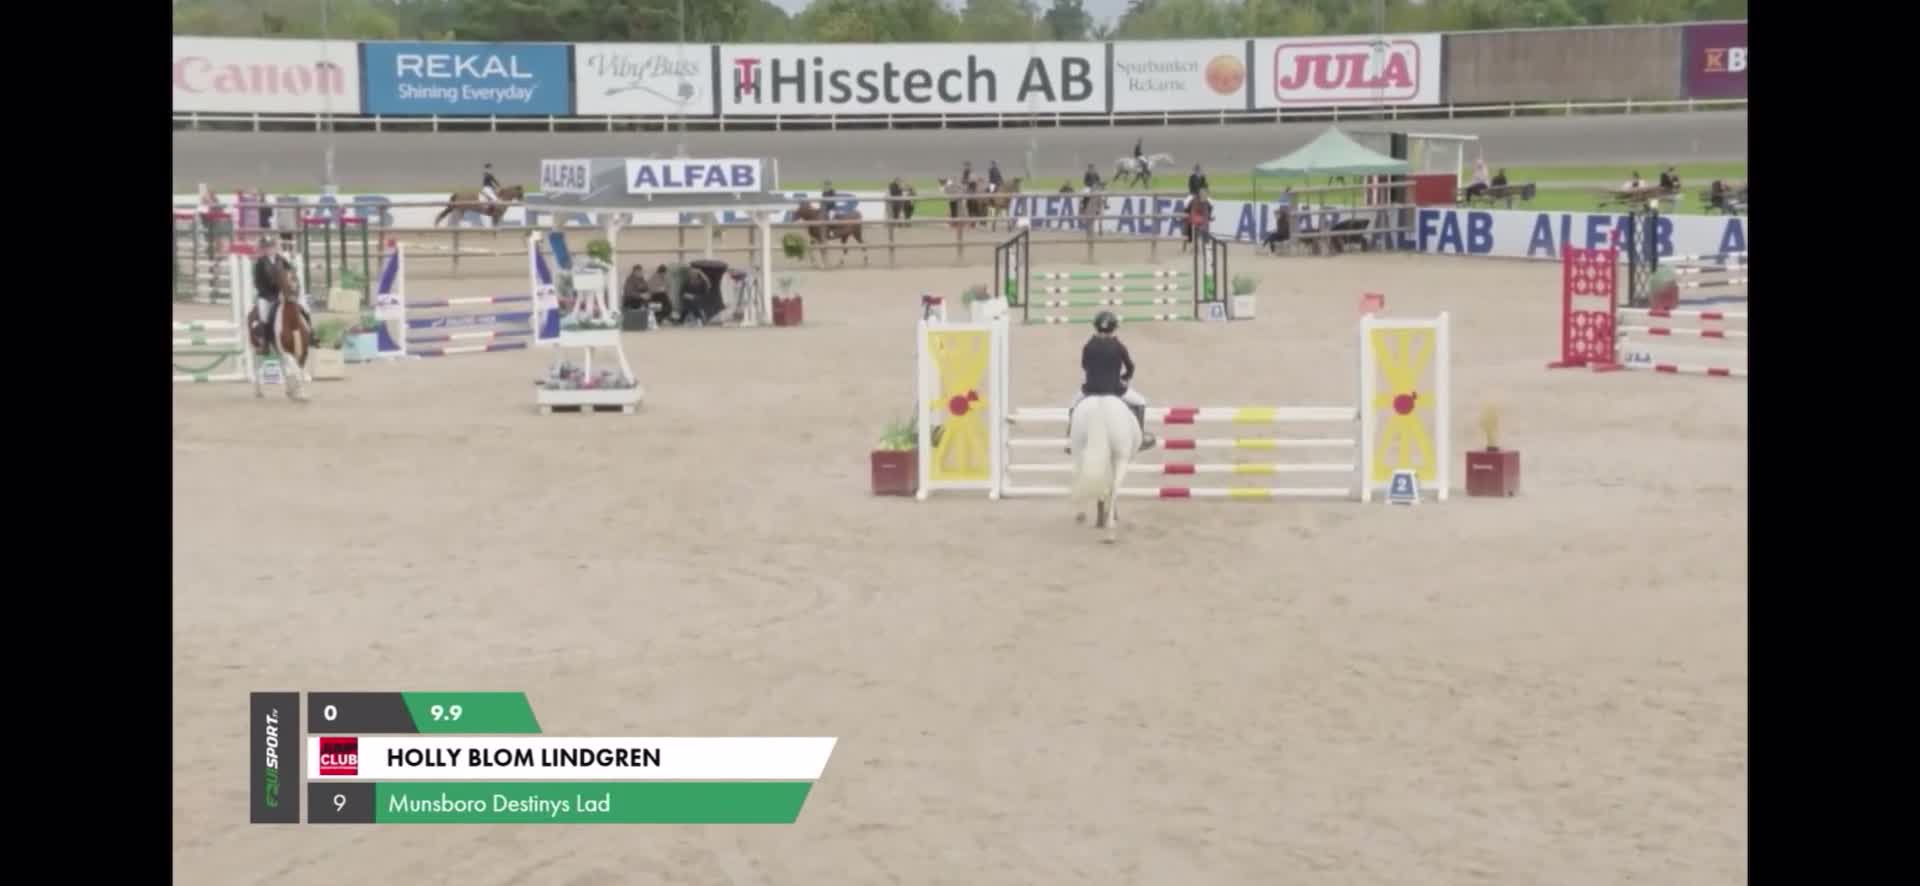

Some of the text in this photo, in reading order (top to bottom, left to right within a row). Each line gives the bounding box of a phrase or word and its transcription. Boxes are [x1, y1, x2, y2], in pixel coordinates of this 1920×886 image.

[172, 55, 346, 96] Canon
[397, 54, 533, 78] REKAL
[1280, 51, 1414, 90] JULA
[771, 54, 997, 104] Hisstech
[1016, 56, 1093, 102] AB
[398, 84, 534, 103] Shining Everyday
[543, 166, 585, 189] ALFAB
[634, 165, 755, 187] ALFAB
[1370, 206, 1495, 254] ALFAB
[1396, 476, 1408, 492] 2
